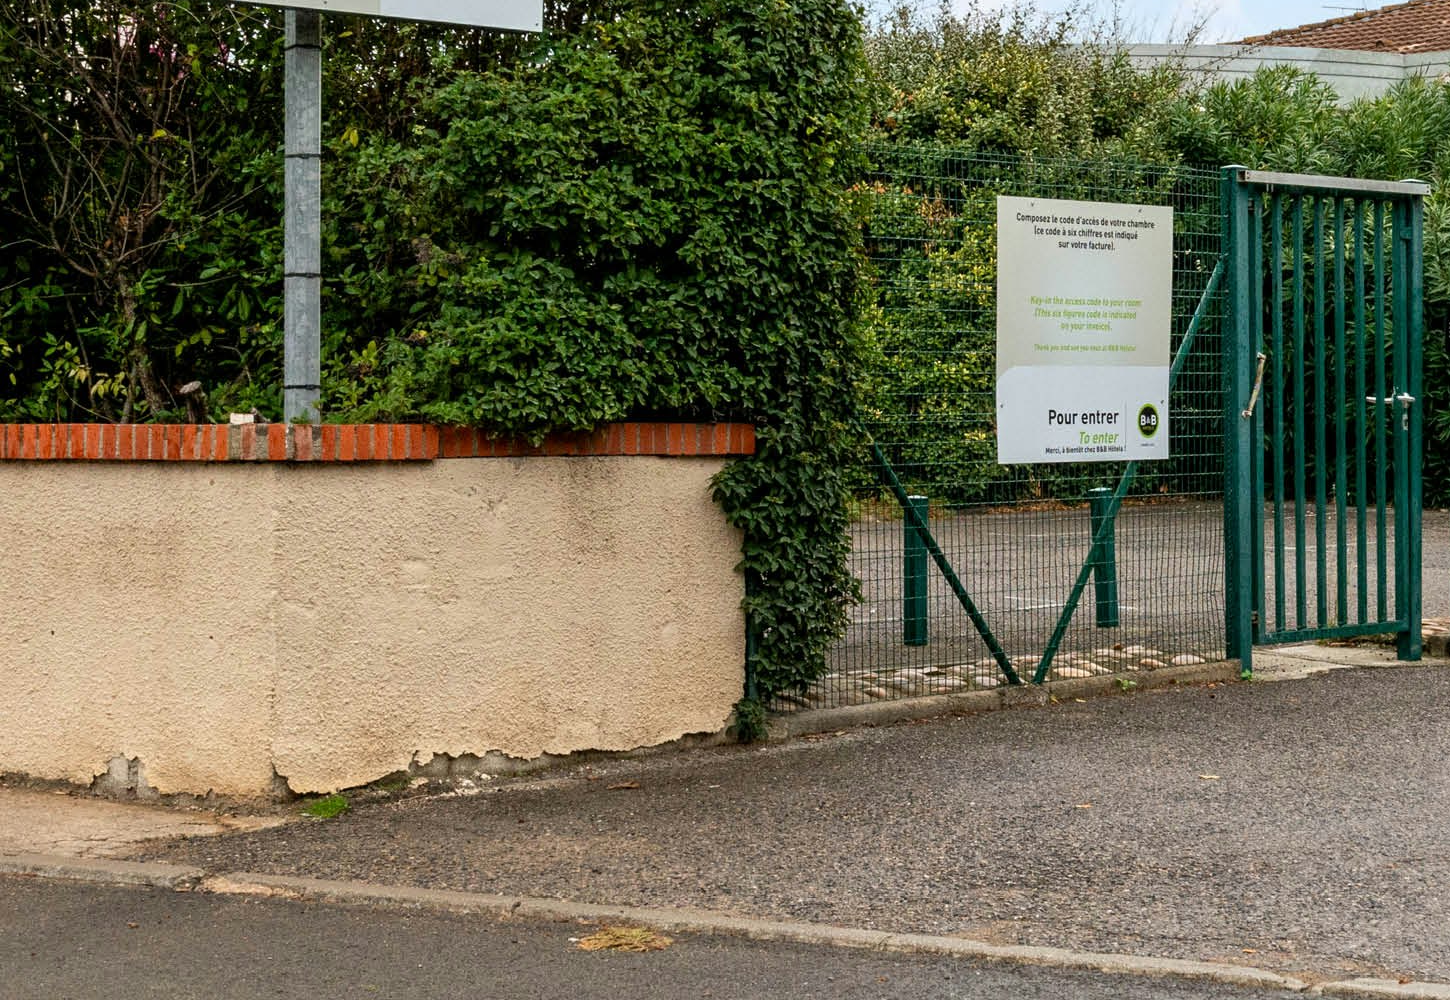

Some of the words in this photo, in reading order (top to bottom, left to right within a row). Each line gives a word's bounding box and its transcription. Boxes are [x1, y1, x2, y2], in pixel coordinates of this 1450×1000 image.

[1016, 212, 1051, 223] Composez
[1051, 214, 1058, 223] le
[1059, 215, 1075, 224] code
[1101, 217, 1109, 226] de
[1110, 218, 1126, 227] votre
[1127, 219, 1155, 229] chambre
[1045, 226, 1061, 236] code
[1062, 226, 1067, 236] à
[1067, 227, 1077, 236] six
[1078, 228, 1103, 238] chiffres
[1104, 231, 1114, 239] est
[1115, 230, 1138, 241] indiqué
[1071, 240, 1088, 249] votre
[1048, 409, 1078, 425] Pour
[1081, 410, 1119, 425] entrer
[1079, 431, 1090, 445] To
[1092, 431, 1119, 444] enter
